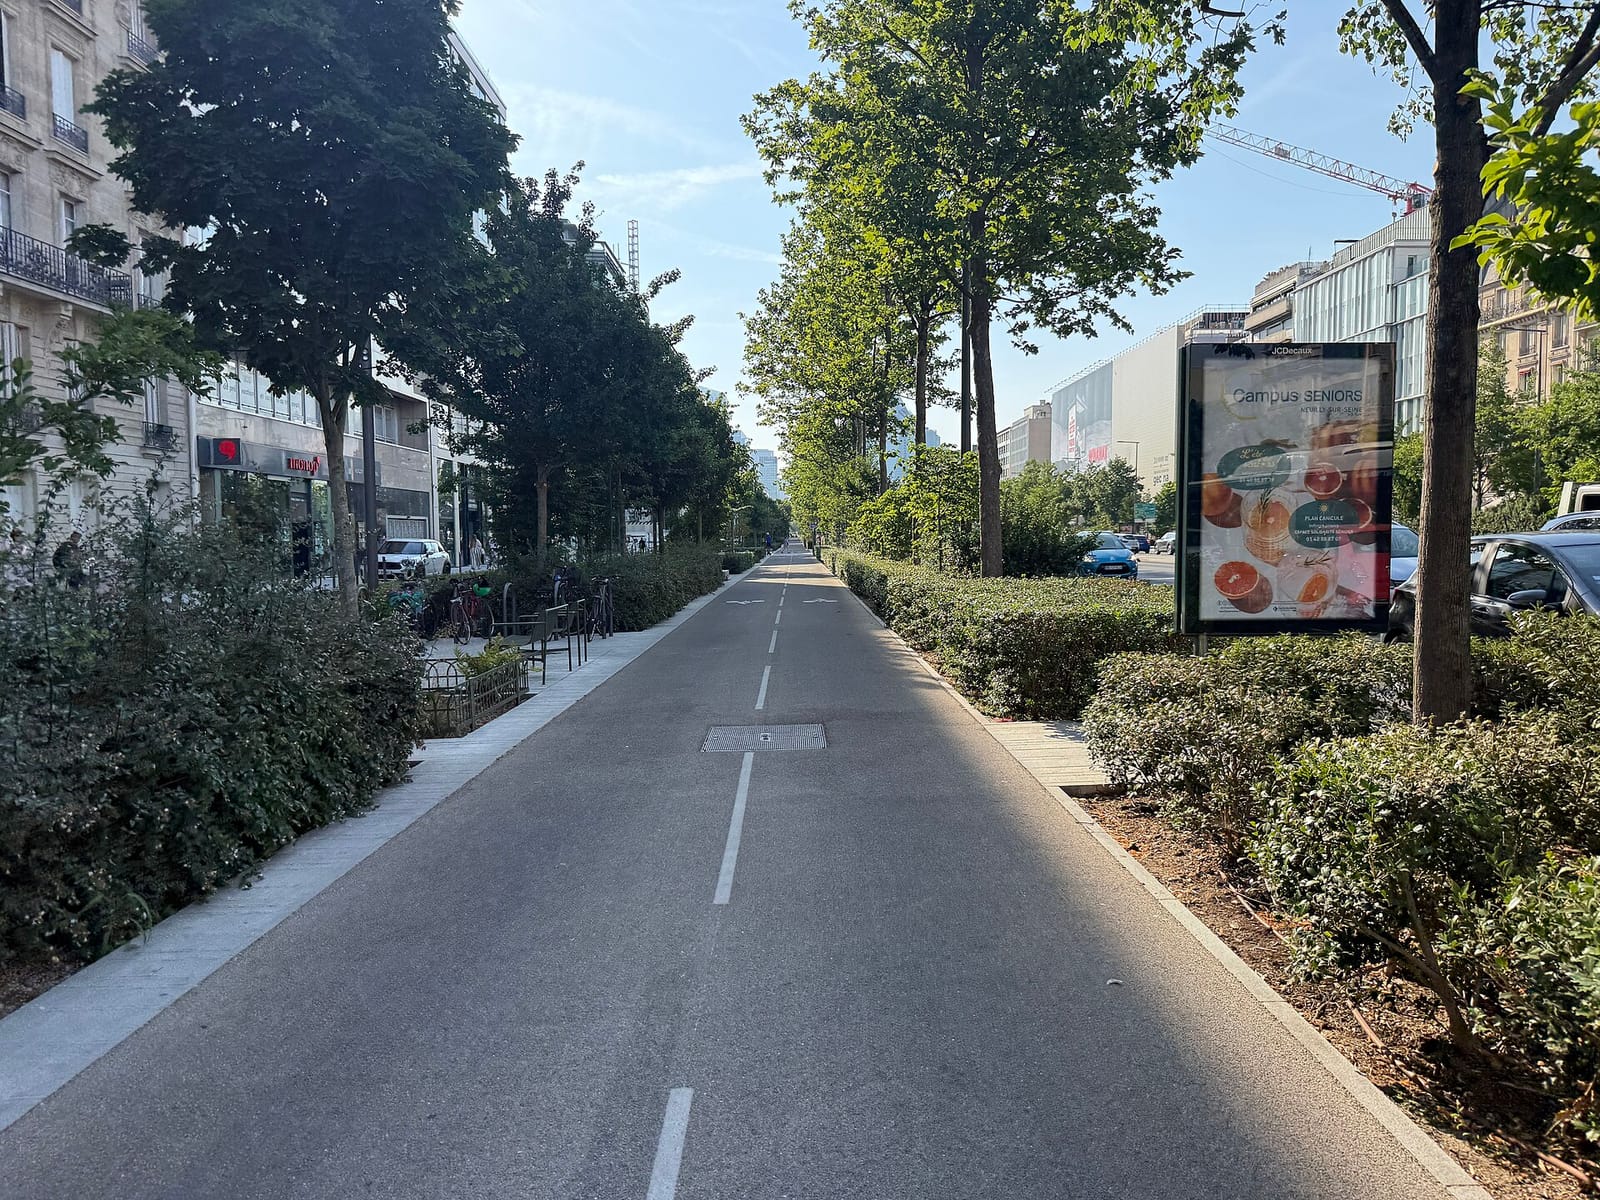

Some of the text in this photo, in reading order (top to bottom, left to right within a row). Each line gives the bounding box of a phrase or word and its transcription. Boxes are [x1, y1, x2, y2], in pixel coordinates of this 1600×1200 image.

[1271, 347, 1312, 355] JCDecaux
[1233, 388, 1363, 405] Campus SENIORS
